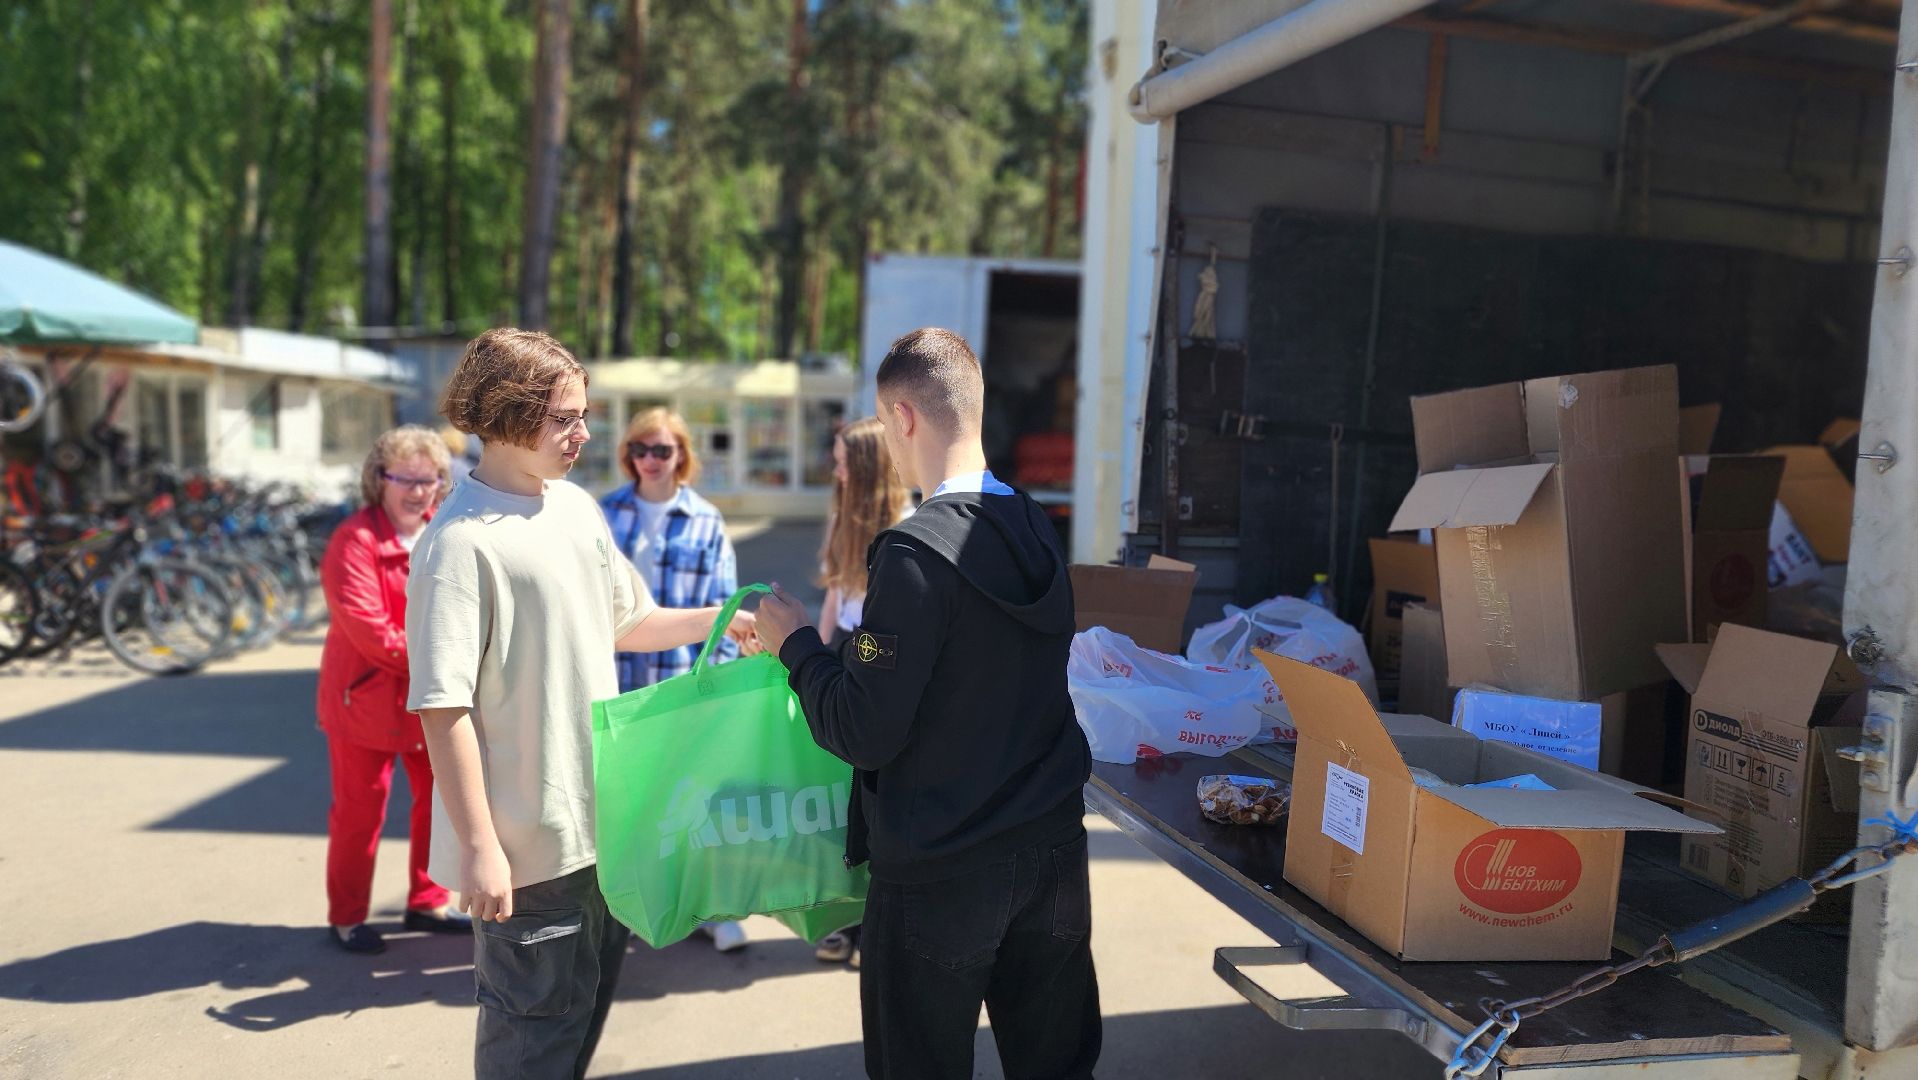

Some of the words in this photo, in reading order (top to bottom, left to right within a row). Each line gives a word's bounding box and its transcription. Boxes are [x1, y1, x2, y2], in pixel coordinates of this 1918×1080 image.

[1484, 721, 1519, 733] МБОУ
[1708, 718, 1741, 737] ДИОЛД
[1504, 865, 1537, 878] НОВ
[1501, 879, 1567, 892] БЫТХИМ
[1459, 902, 1574, 928] www.newchem.ru
